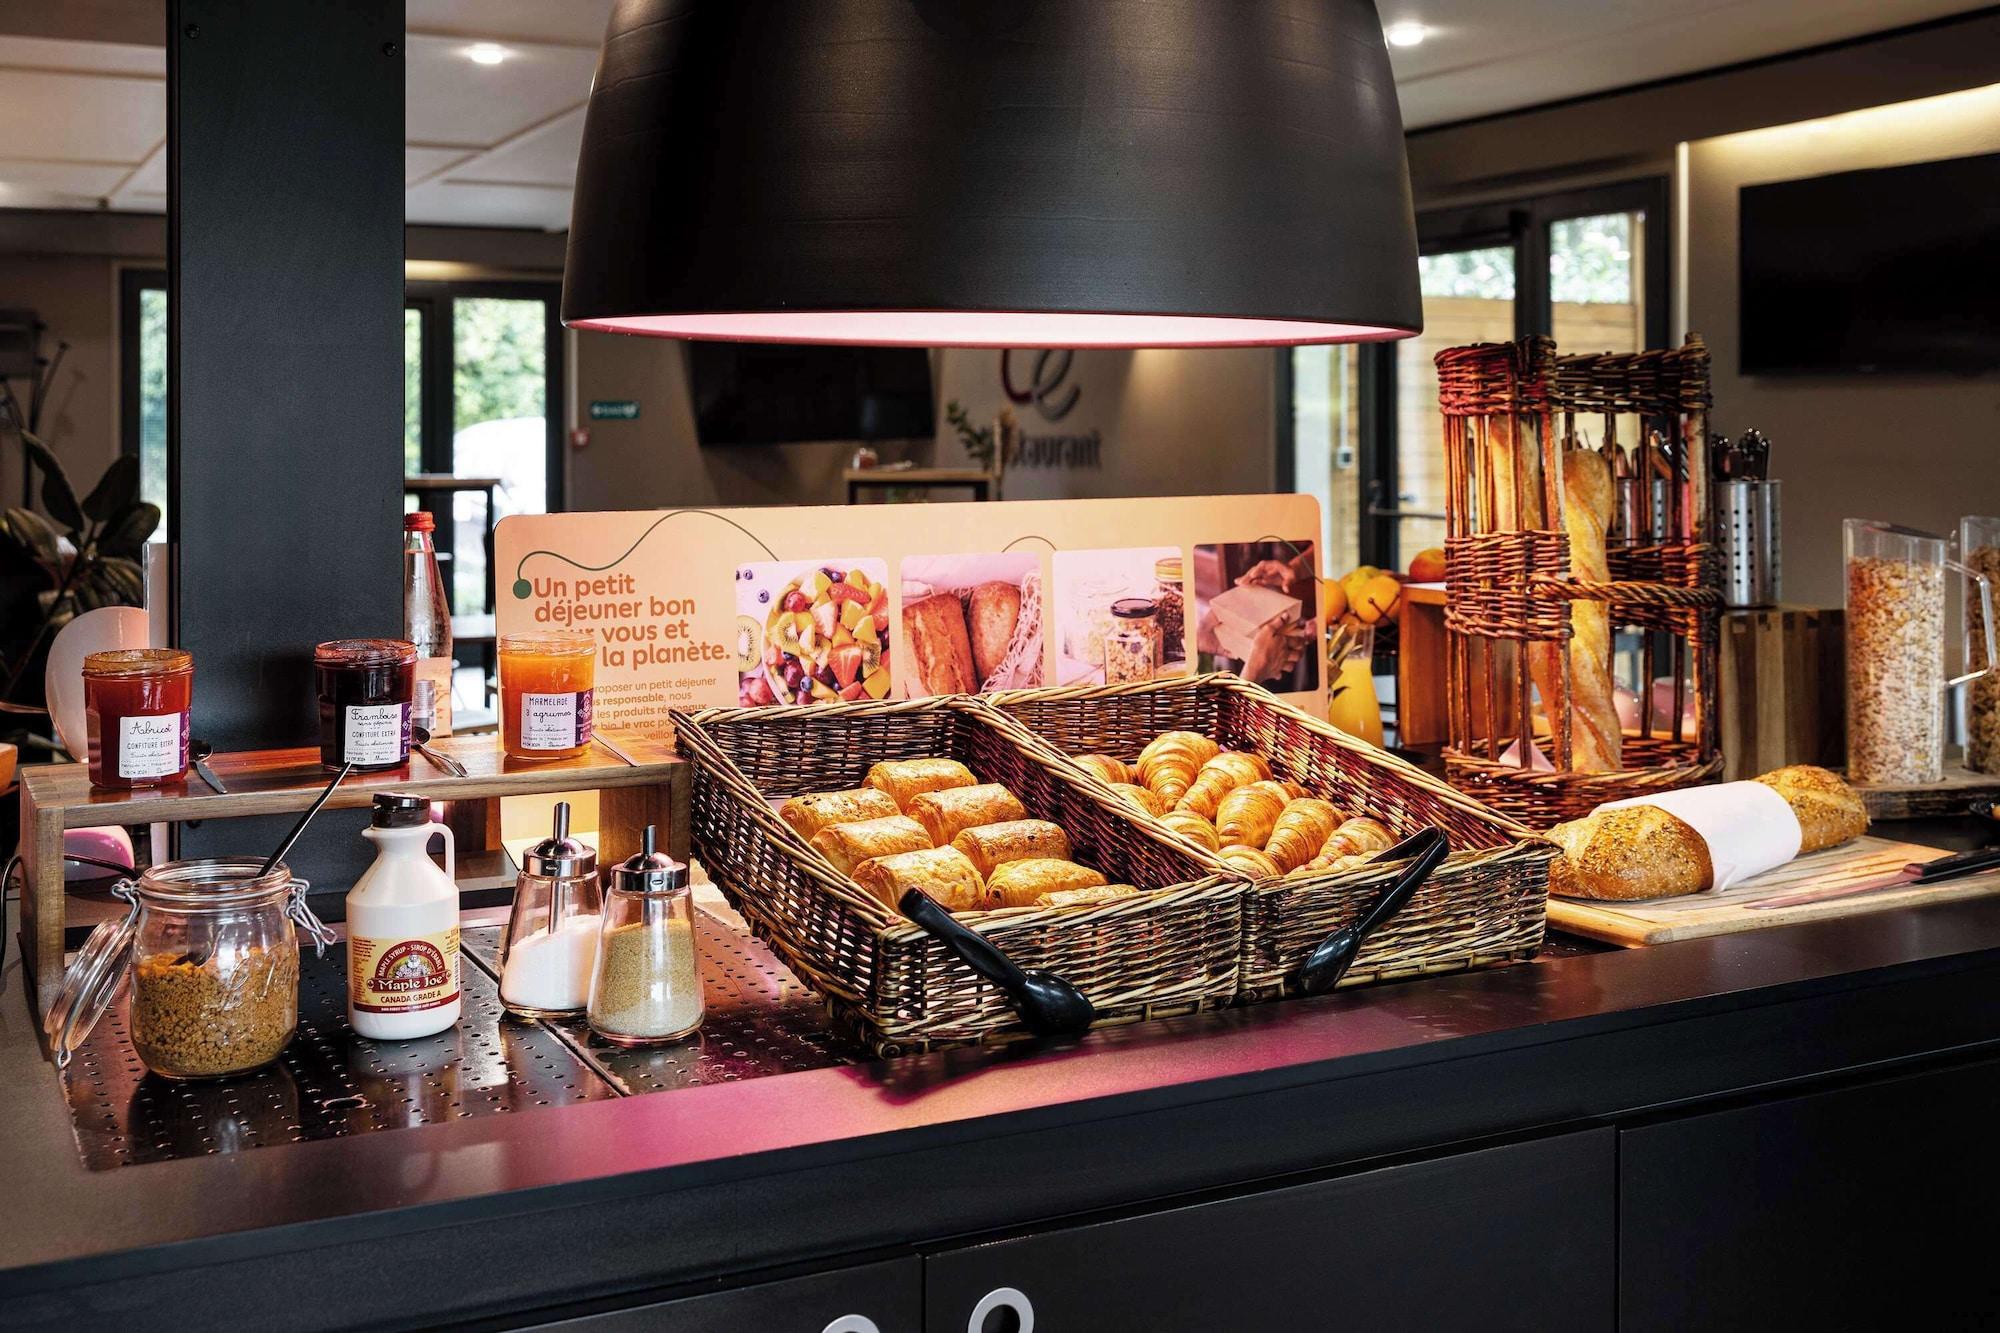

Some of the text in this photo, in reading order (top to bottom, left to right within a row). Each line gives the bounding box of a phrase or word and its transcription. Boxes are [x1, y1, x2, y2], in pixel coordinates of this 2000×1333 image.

[534, 574, 636, 601] Un petit
[535, 596, 695, 627] déjeuner bon
[601, 624, 657, 643] vous
[665, 619, 689, 639] et
[603, 643, 731, 670] la planète.
[594, 677, 717, 694] roposer un petit déjeuner
[529, 697, 568, 706] MARMELADE
[669, 691, 692, 701] nous
[351, 708, 398, 720] Framboise
[533, 710, 572, 724] agrumes
[597, 709, 611, 719] les
[613, 707, 655, 719] produits
[130, 720, 172, 735] Abricot
[622, 720, 631, 729] le
[633, 719, 655, 729] vrac
[127, 741, 158, 750] CONFITURE
[378, 973, 443, 993] Maple Joe
[380, 994, 412, 1004] CANADA
[413, 991, 436, 1002] GRADE
